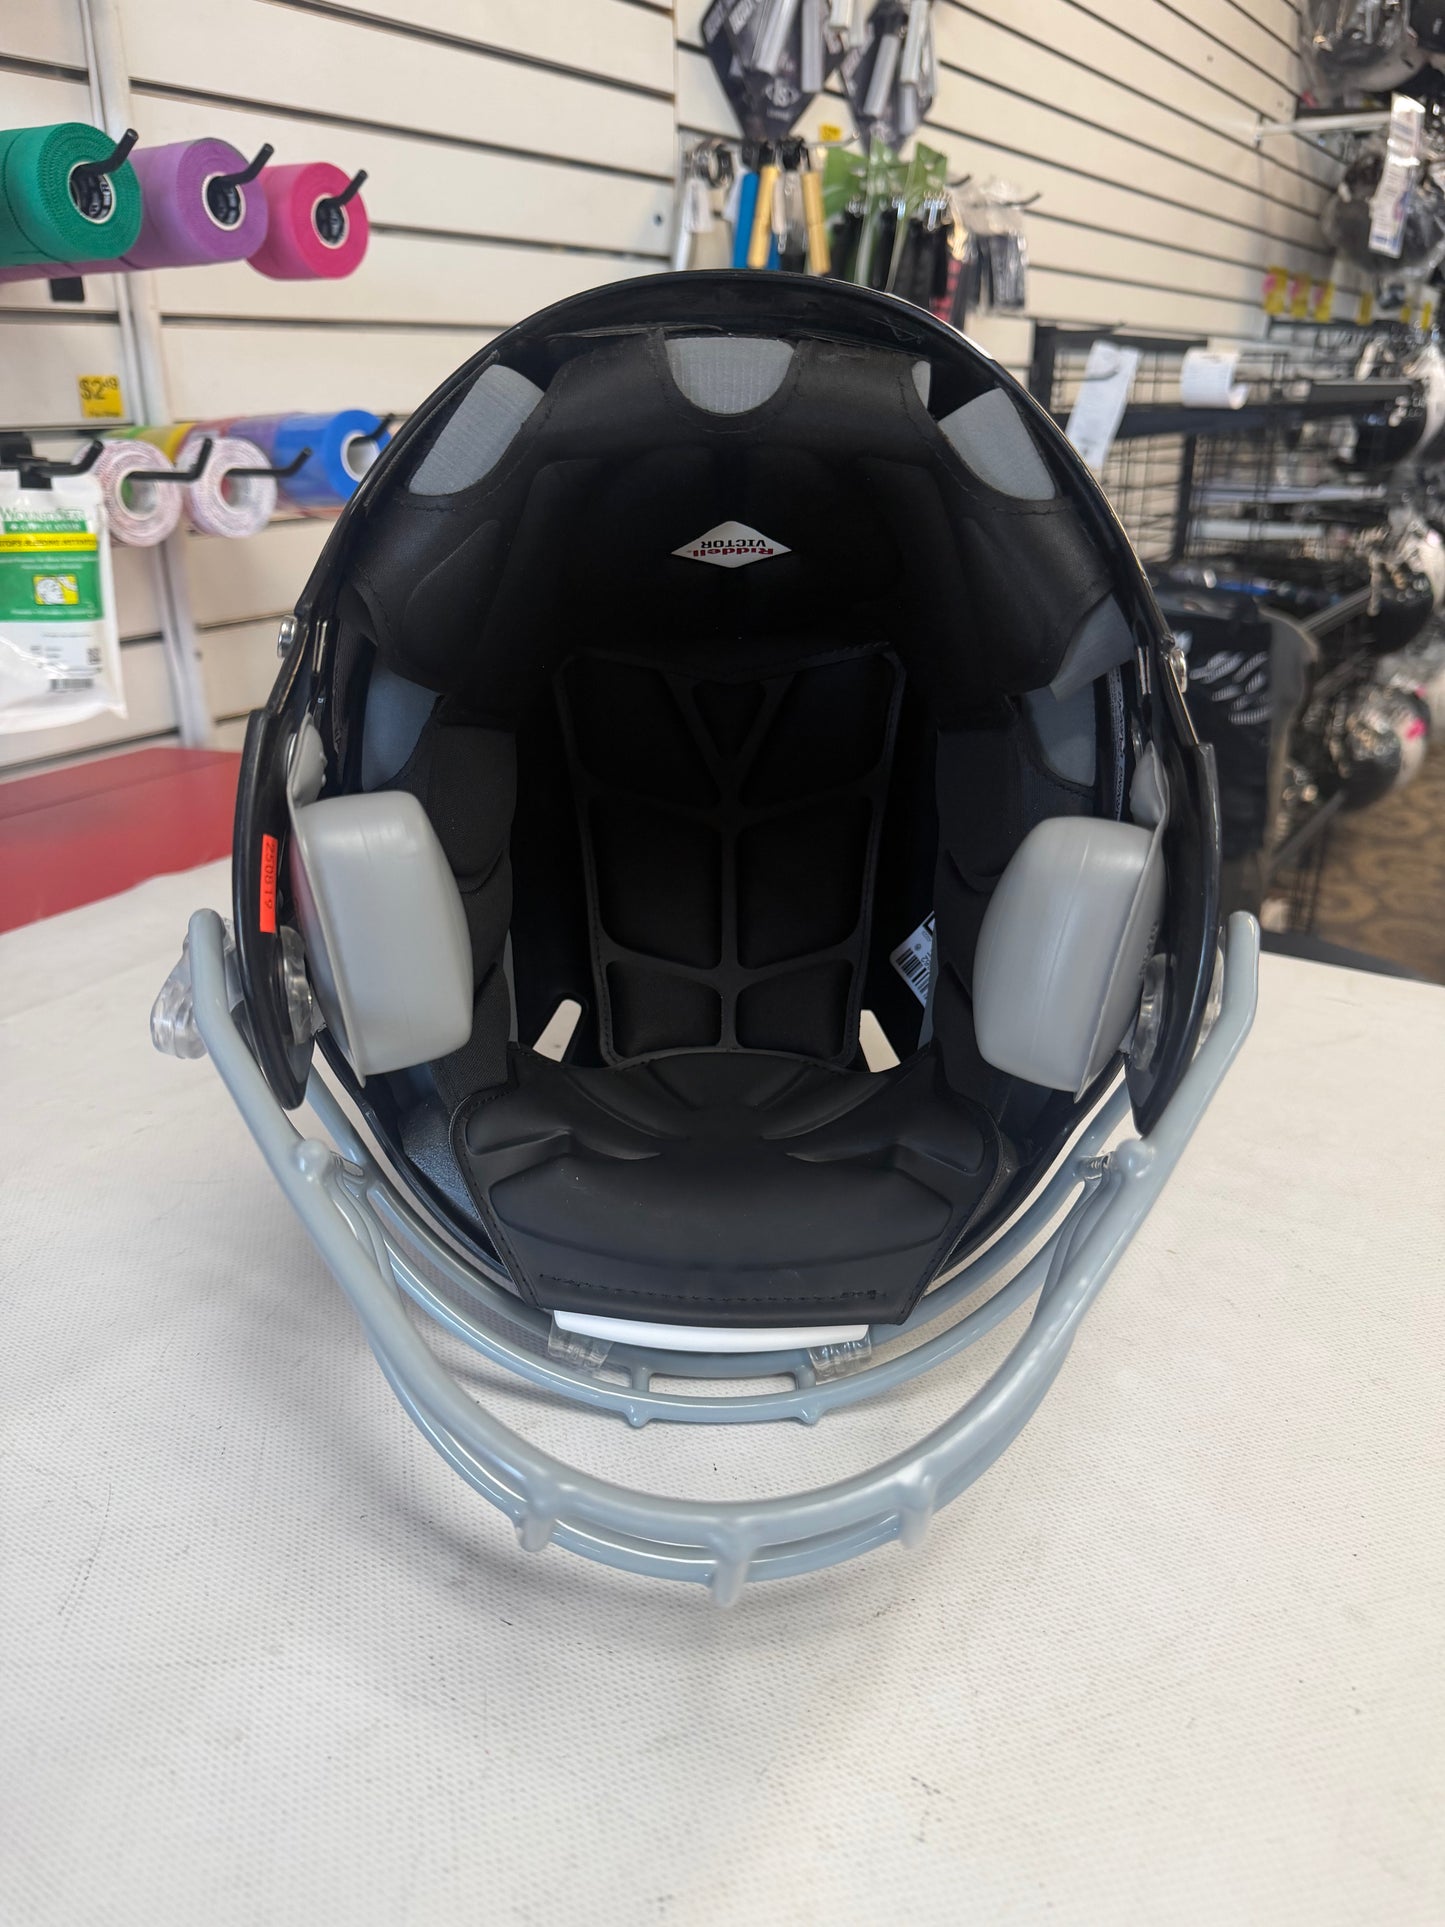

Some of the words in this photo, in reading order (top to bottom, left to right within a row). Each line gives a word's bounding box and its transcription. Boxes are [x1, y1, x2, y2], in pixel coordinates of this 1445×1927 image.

[701, 539, 766, 548] VICTOR
[693, 548, 774, 557] Riddell
[264, 842, 275, 909] 250819
